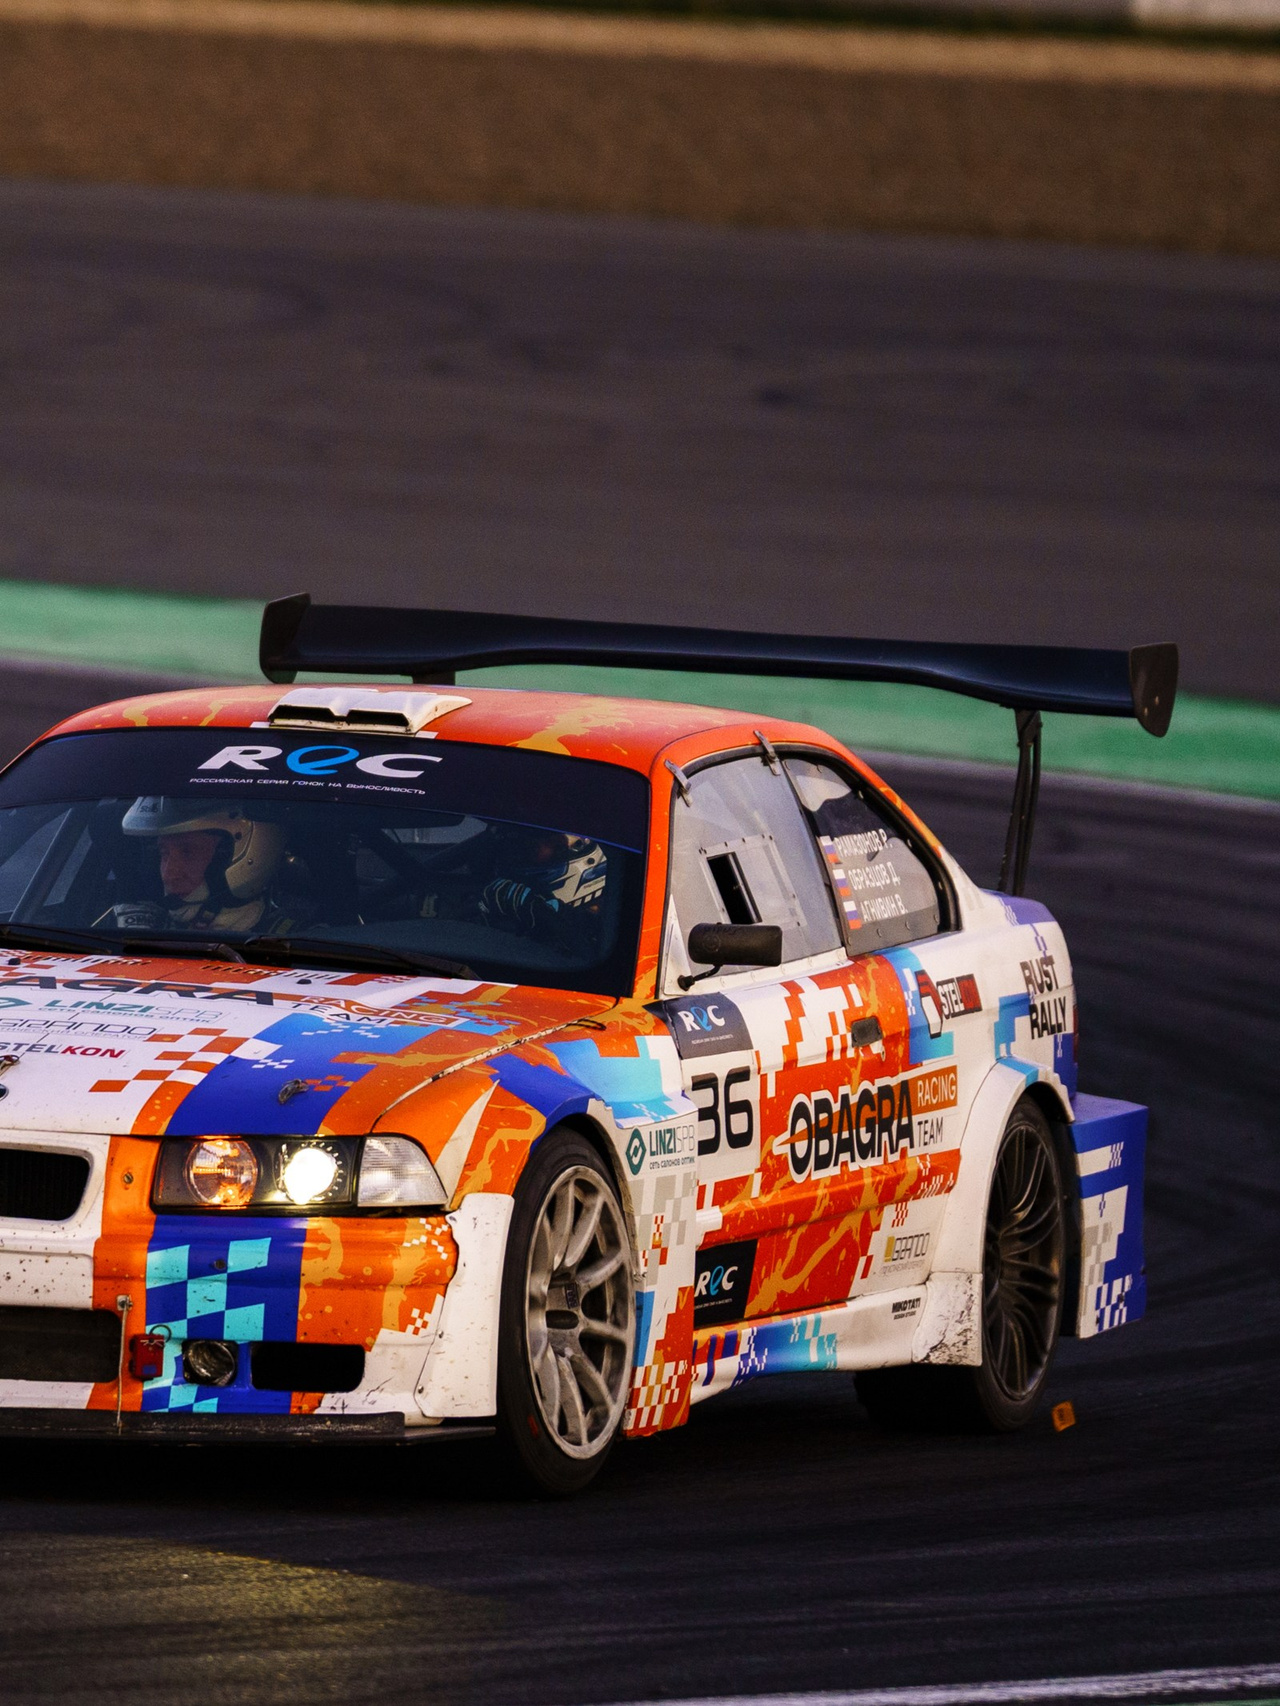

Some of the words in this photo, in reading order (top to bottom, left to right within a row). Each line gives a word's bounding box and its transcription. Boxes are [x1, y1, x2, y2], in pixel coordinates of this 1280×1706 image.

[346, 783, 426, 795] ВЫНОСЛИВОСТЬ
[1020, 955, 1059, 995] RUST
[292, 1002, 388, 1024] TEAM
[300, 996, 448, 1022] RACING
[1029, 996, 1067, 1040] RALLY
[917, 1074, 956, 1107] RACING
[691, 1065, 754, 1157] 36
[789, 1078, 915, 1176] OBAGRA
[917, 1117, 944, 1147] TEAM
